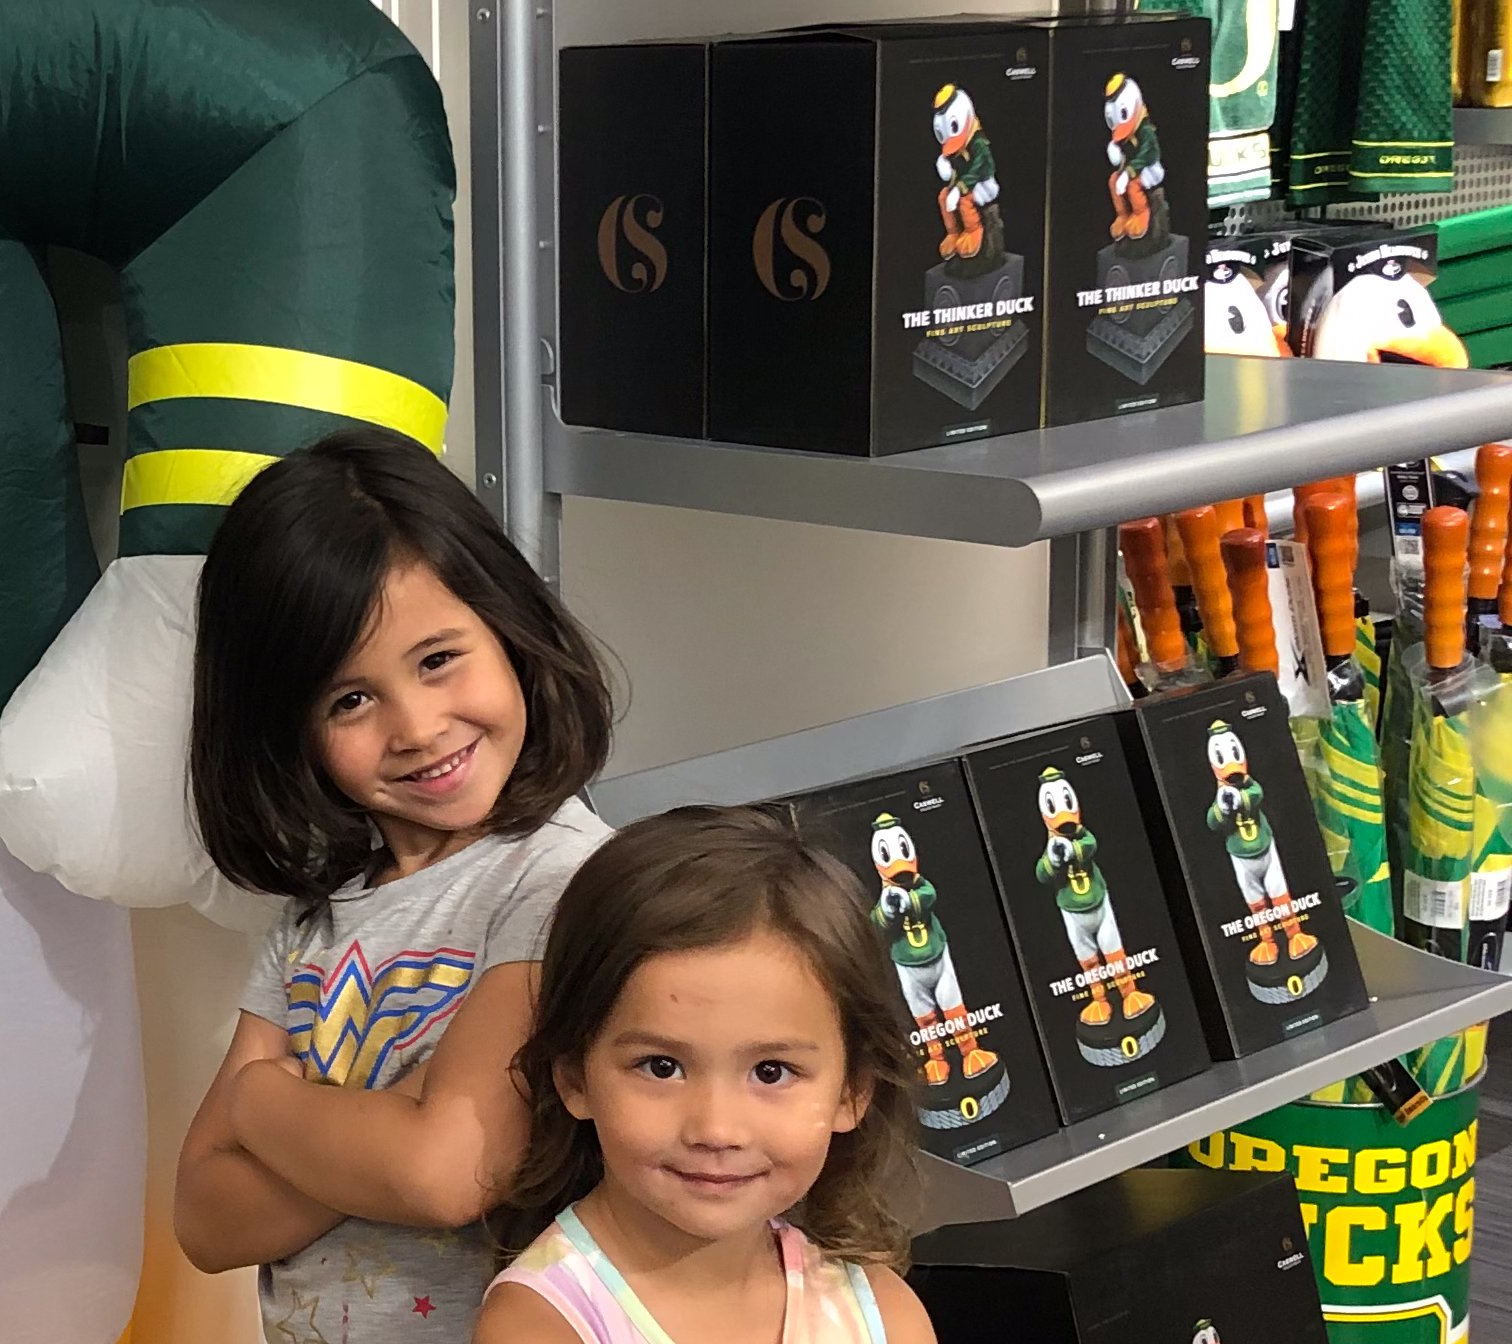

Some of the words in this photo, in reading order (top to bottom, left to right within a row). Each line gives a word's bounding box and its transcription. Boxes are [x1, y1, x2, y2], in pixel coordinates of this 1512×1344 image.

[902, 312, 930, 329] THE
[934, 301, 993, 324] THINKER
[996, 296, 1034, 316] DUCK
[1077, 290, 1103, 307] THE
[1106, 282, 1160, 303] THINKER
[1163, 276, 1200, 295] DUCK
[1220, 919, 1244, 937] THE
[1244, 905, 1290, 930] OREGON
[1290, 892, 1322, 913] DUCK
[1049, 977, 1075, 996] THE
[1075, 960, 1126, 987] OREGON
[1125, 948, 1160, 970] DUCK
[909, 1016, 967, 1046] OREGON
[966, 1003, 1004, 1027] DUCK
[1188, 1119, 1478, 1194] OREGON
[1300, 1178, 1475, 1287] CKS
